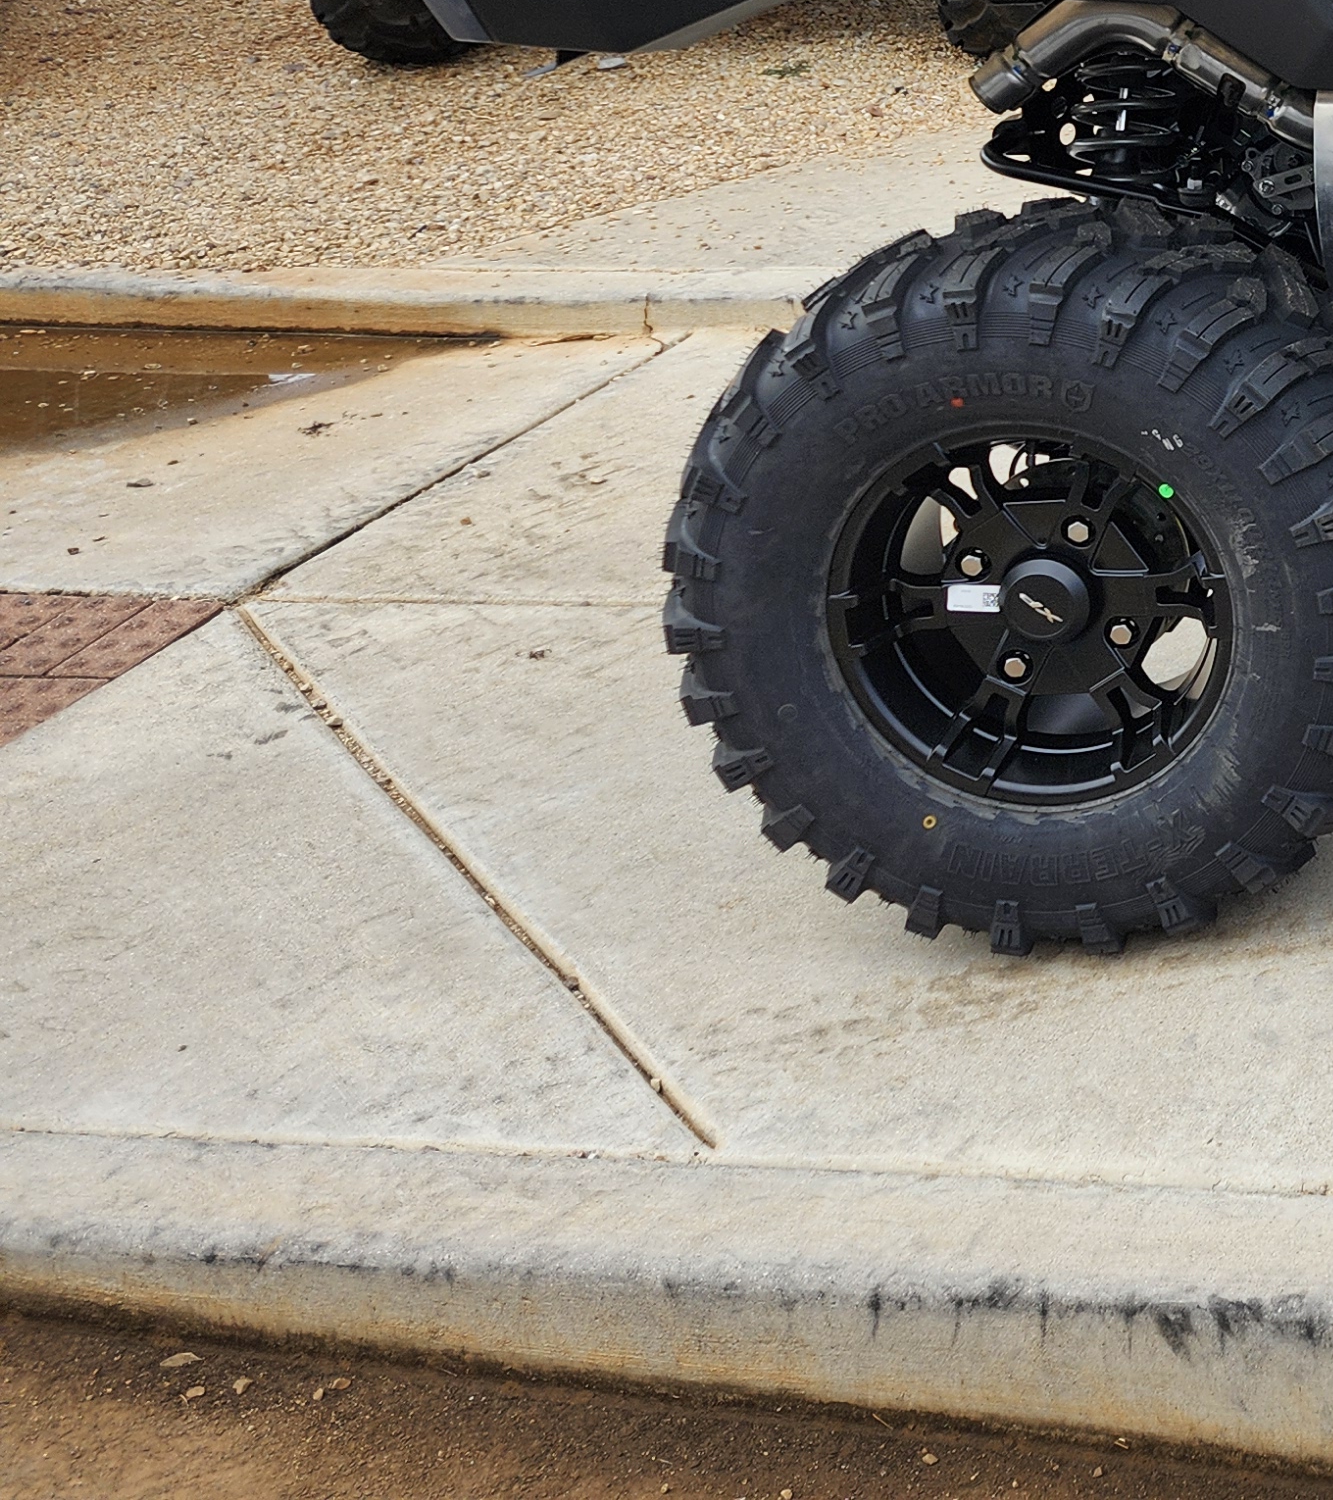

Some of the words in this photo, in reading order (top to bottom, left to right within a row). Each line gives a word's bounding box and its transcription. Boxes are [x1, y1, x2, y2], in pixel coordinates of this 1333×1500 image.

[832, 393, 910, 445] PRO
[914, 371, 1053, 409] ARMOR
[1019, 592, 1063, 624] XP
[947, 807, 1192, 888] X-TERRAIN
